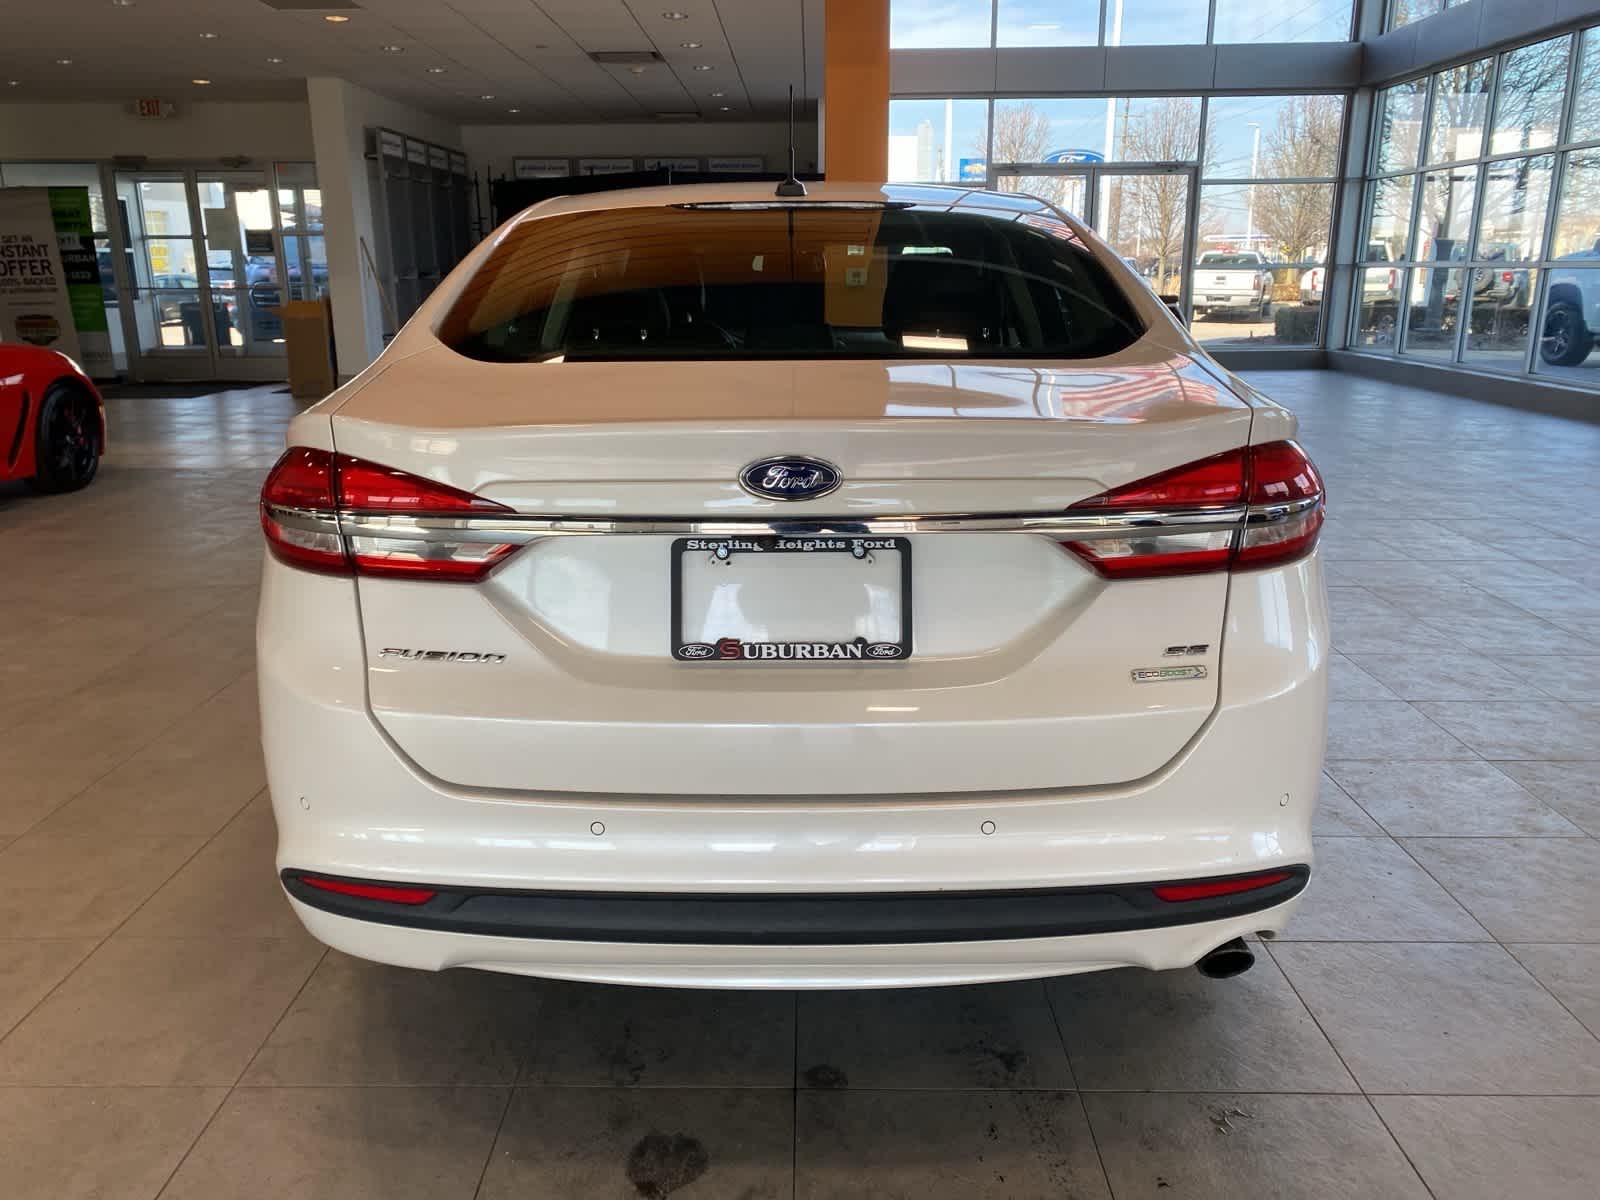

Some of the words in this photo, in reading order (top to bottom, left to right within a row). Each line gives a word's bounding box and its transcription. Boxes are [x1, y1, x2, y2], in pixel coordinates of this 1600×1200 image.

[139, 98, 160, 116] EXIT
[0, 259, 54, 276] OFFER
[762, 465, 824, 489] Ford
[851, 539, 896, 550] Ford
[378, 647, 508, 664] FUSION
[685, 645, 708, 656] Ford
[719, 639, 863, 660] SUBURBAN
[871, 645, 895, 656] Ford
